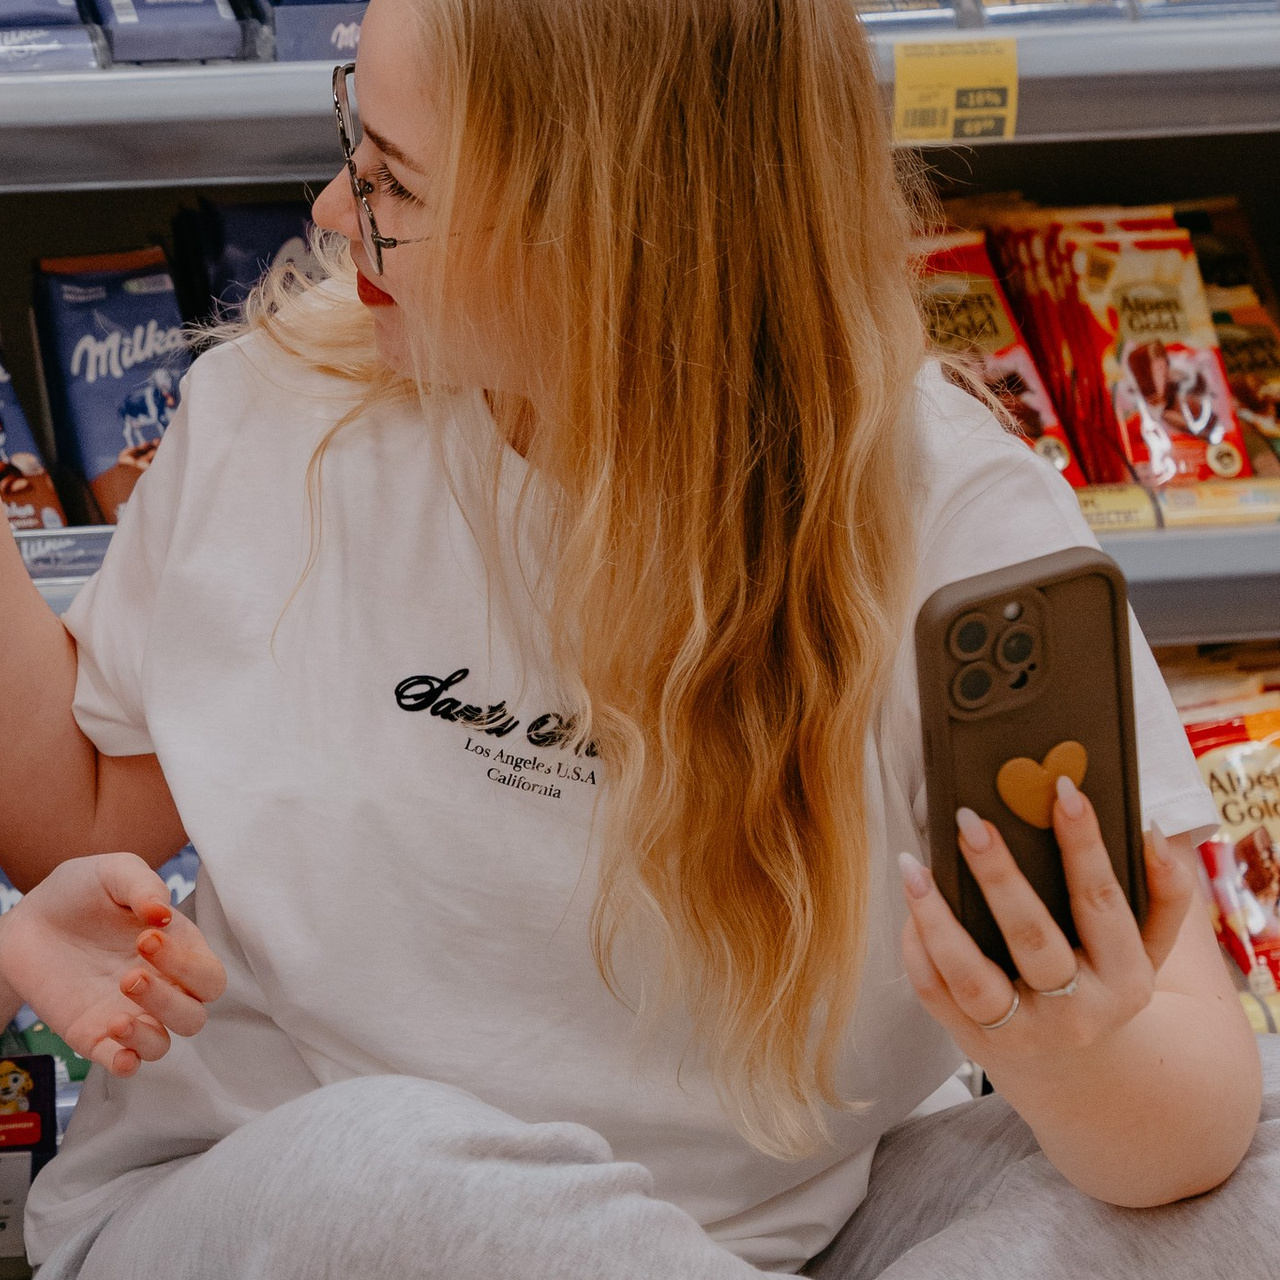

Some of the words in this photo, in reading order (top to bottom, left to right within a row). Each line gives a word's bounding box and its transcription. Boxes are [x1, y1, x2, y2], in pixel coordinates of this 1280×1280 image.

[70, 320, 184, 382] Milka
[464, 738, 491, 758] Los
[493, 748, 552, 775] Angeles
[556, 762, 597, 785] U.S.A
[486, 767, 562, 799] California
